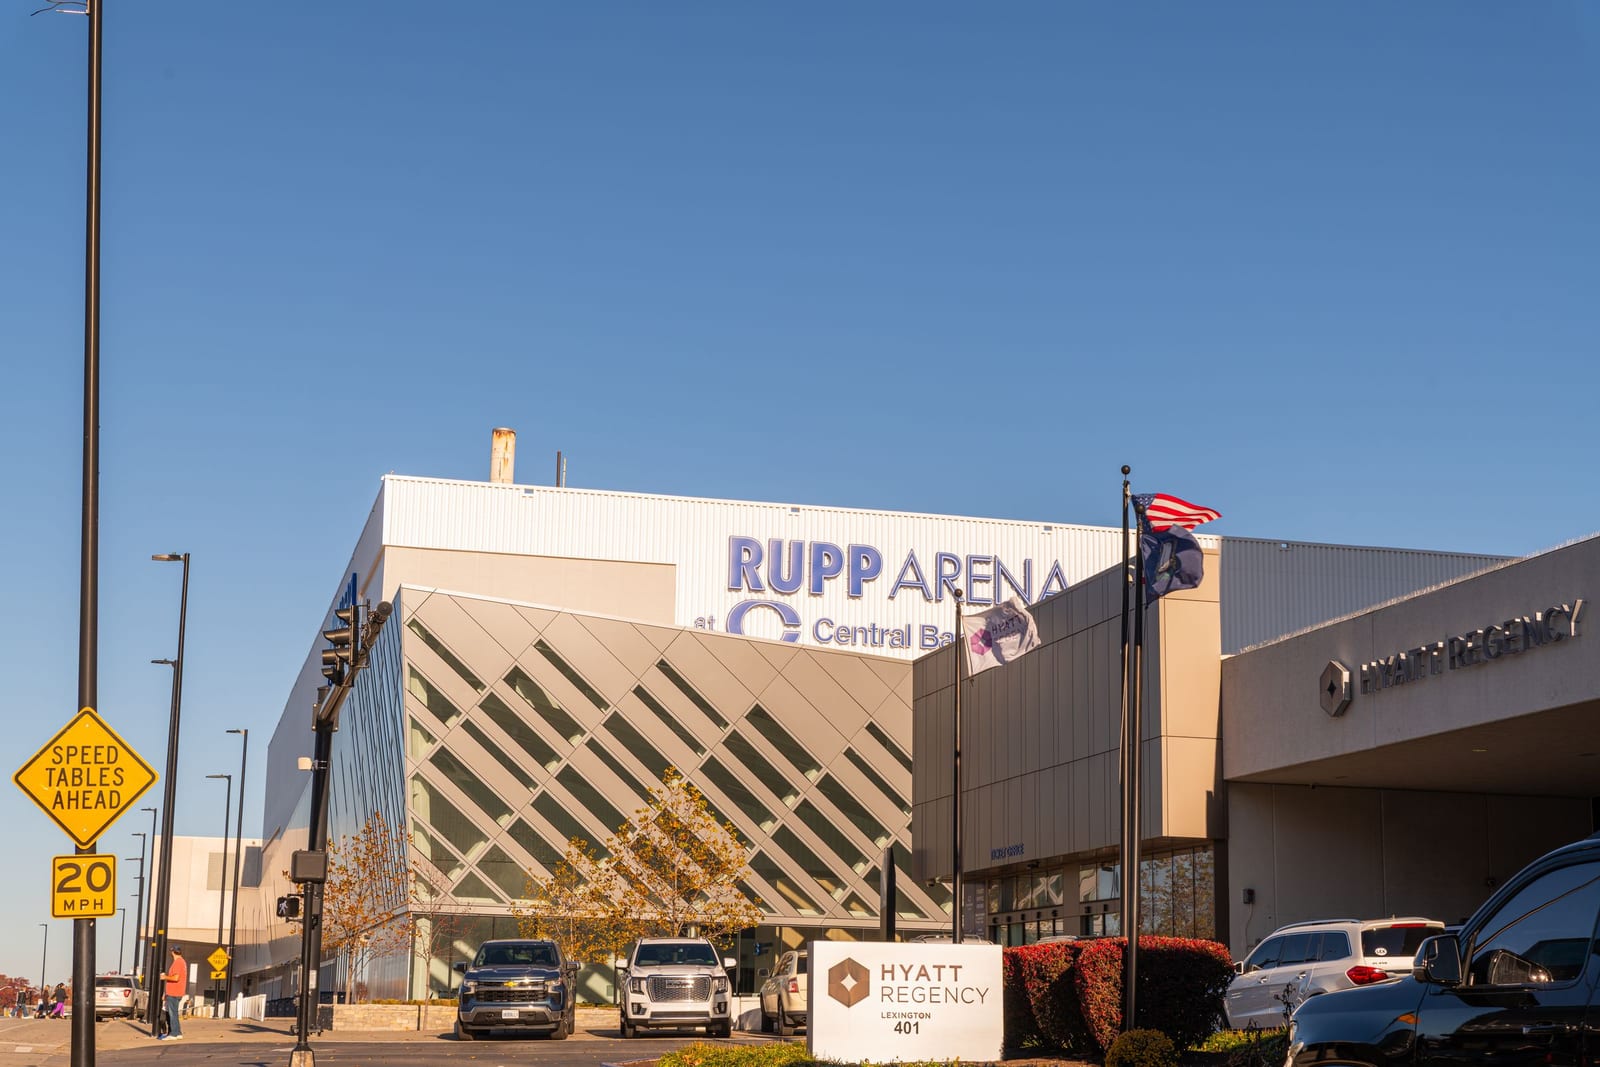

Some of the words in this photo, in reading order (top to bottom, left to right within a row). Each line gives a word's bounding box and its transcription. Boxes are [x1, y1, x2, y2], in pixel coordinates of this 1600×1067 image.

[728, 535, 883, 599] RUPP
[888, 548, 1069, 607] ARENA
[813, 617, 912, 649] Central
[920, 624, 965, 649] Ba
[1360, 641, 1444, 695] HYATT
[1448, 599, 1584, 670] REGENCY
[51, 745, 119, 765] SPEED
[45, 767, 125, 787] TABLES
[52, 790, 121, 810] AHEAD
[56, 862, 112, 893] 20
[63, 898, 104, 911] MPH
[881, 964, 963, 982] HYATT
[881, 986, 990, 1004] REGENCY
[894, 1021, 920, 1035] 401
